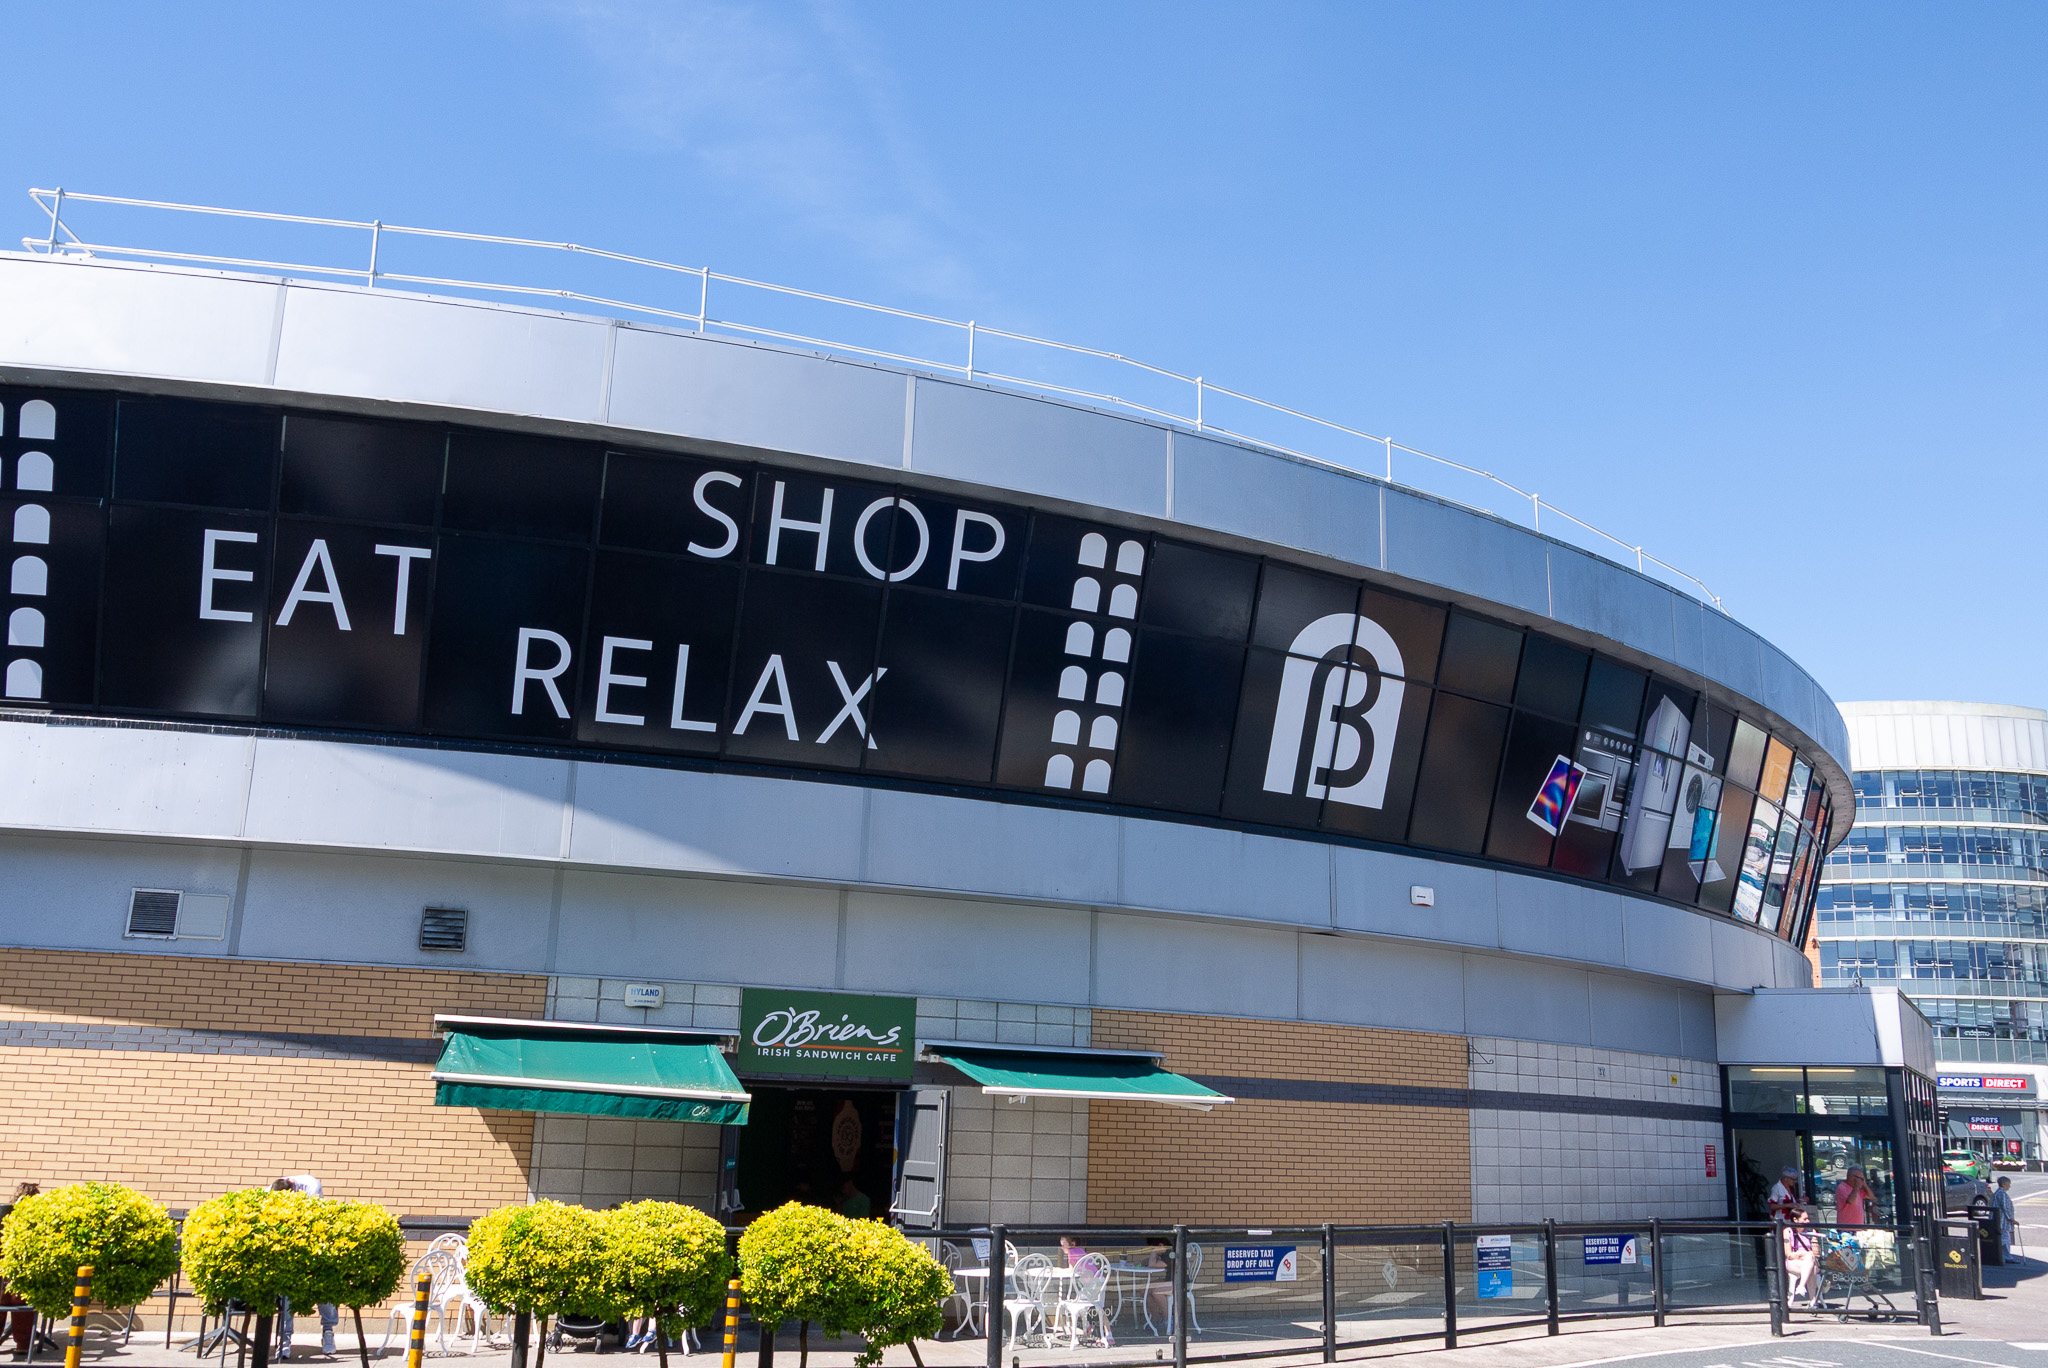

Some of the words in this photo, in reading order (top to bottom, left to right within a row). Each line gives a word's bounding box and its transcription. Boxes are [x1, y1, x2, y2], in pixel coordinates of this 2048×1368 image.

[687, 470, 1006, 591] SHOP
[199, 528, 432, 635] EAT
[511, 627, 889, 750] RELAX
[752, 1006, 902, 1048] O'Briens
[757, 1047, 790, 1058] IRISH
[796, 1049, 861, 1061] SANDWICH
[866, 1052, 897, 1063] CAFE
[1939, 1077, 1981, 1087] SPORTS
[1985, 1079, 2024, 1088] DIRECT
[1970, 1116, 1999, 1124] SPORTS
[1608, 1237, 1619, 1245] TAXI
[1227, 1250, 1259, 1259] RESERVED
[1260, 1249, 1274, 1258] TAXI
[1227, 1260, 1244, 1269] DROP
[1245, 1260, 1257, 1268] OFF
[1258, 1259, 1274, 1268] ONLY
